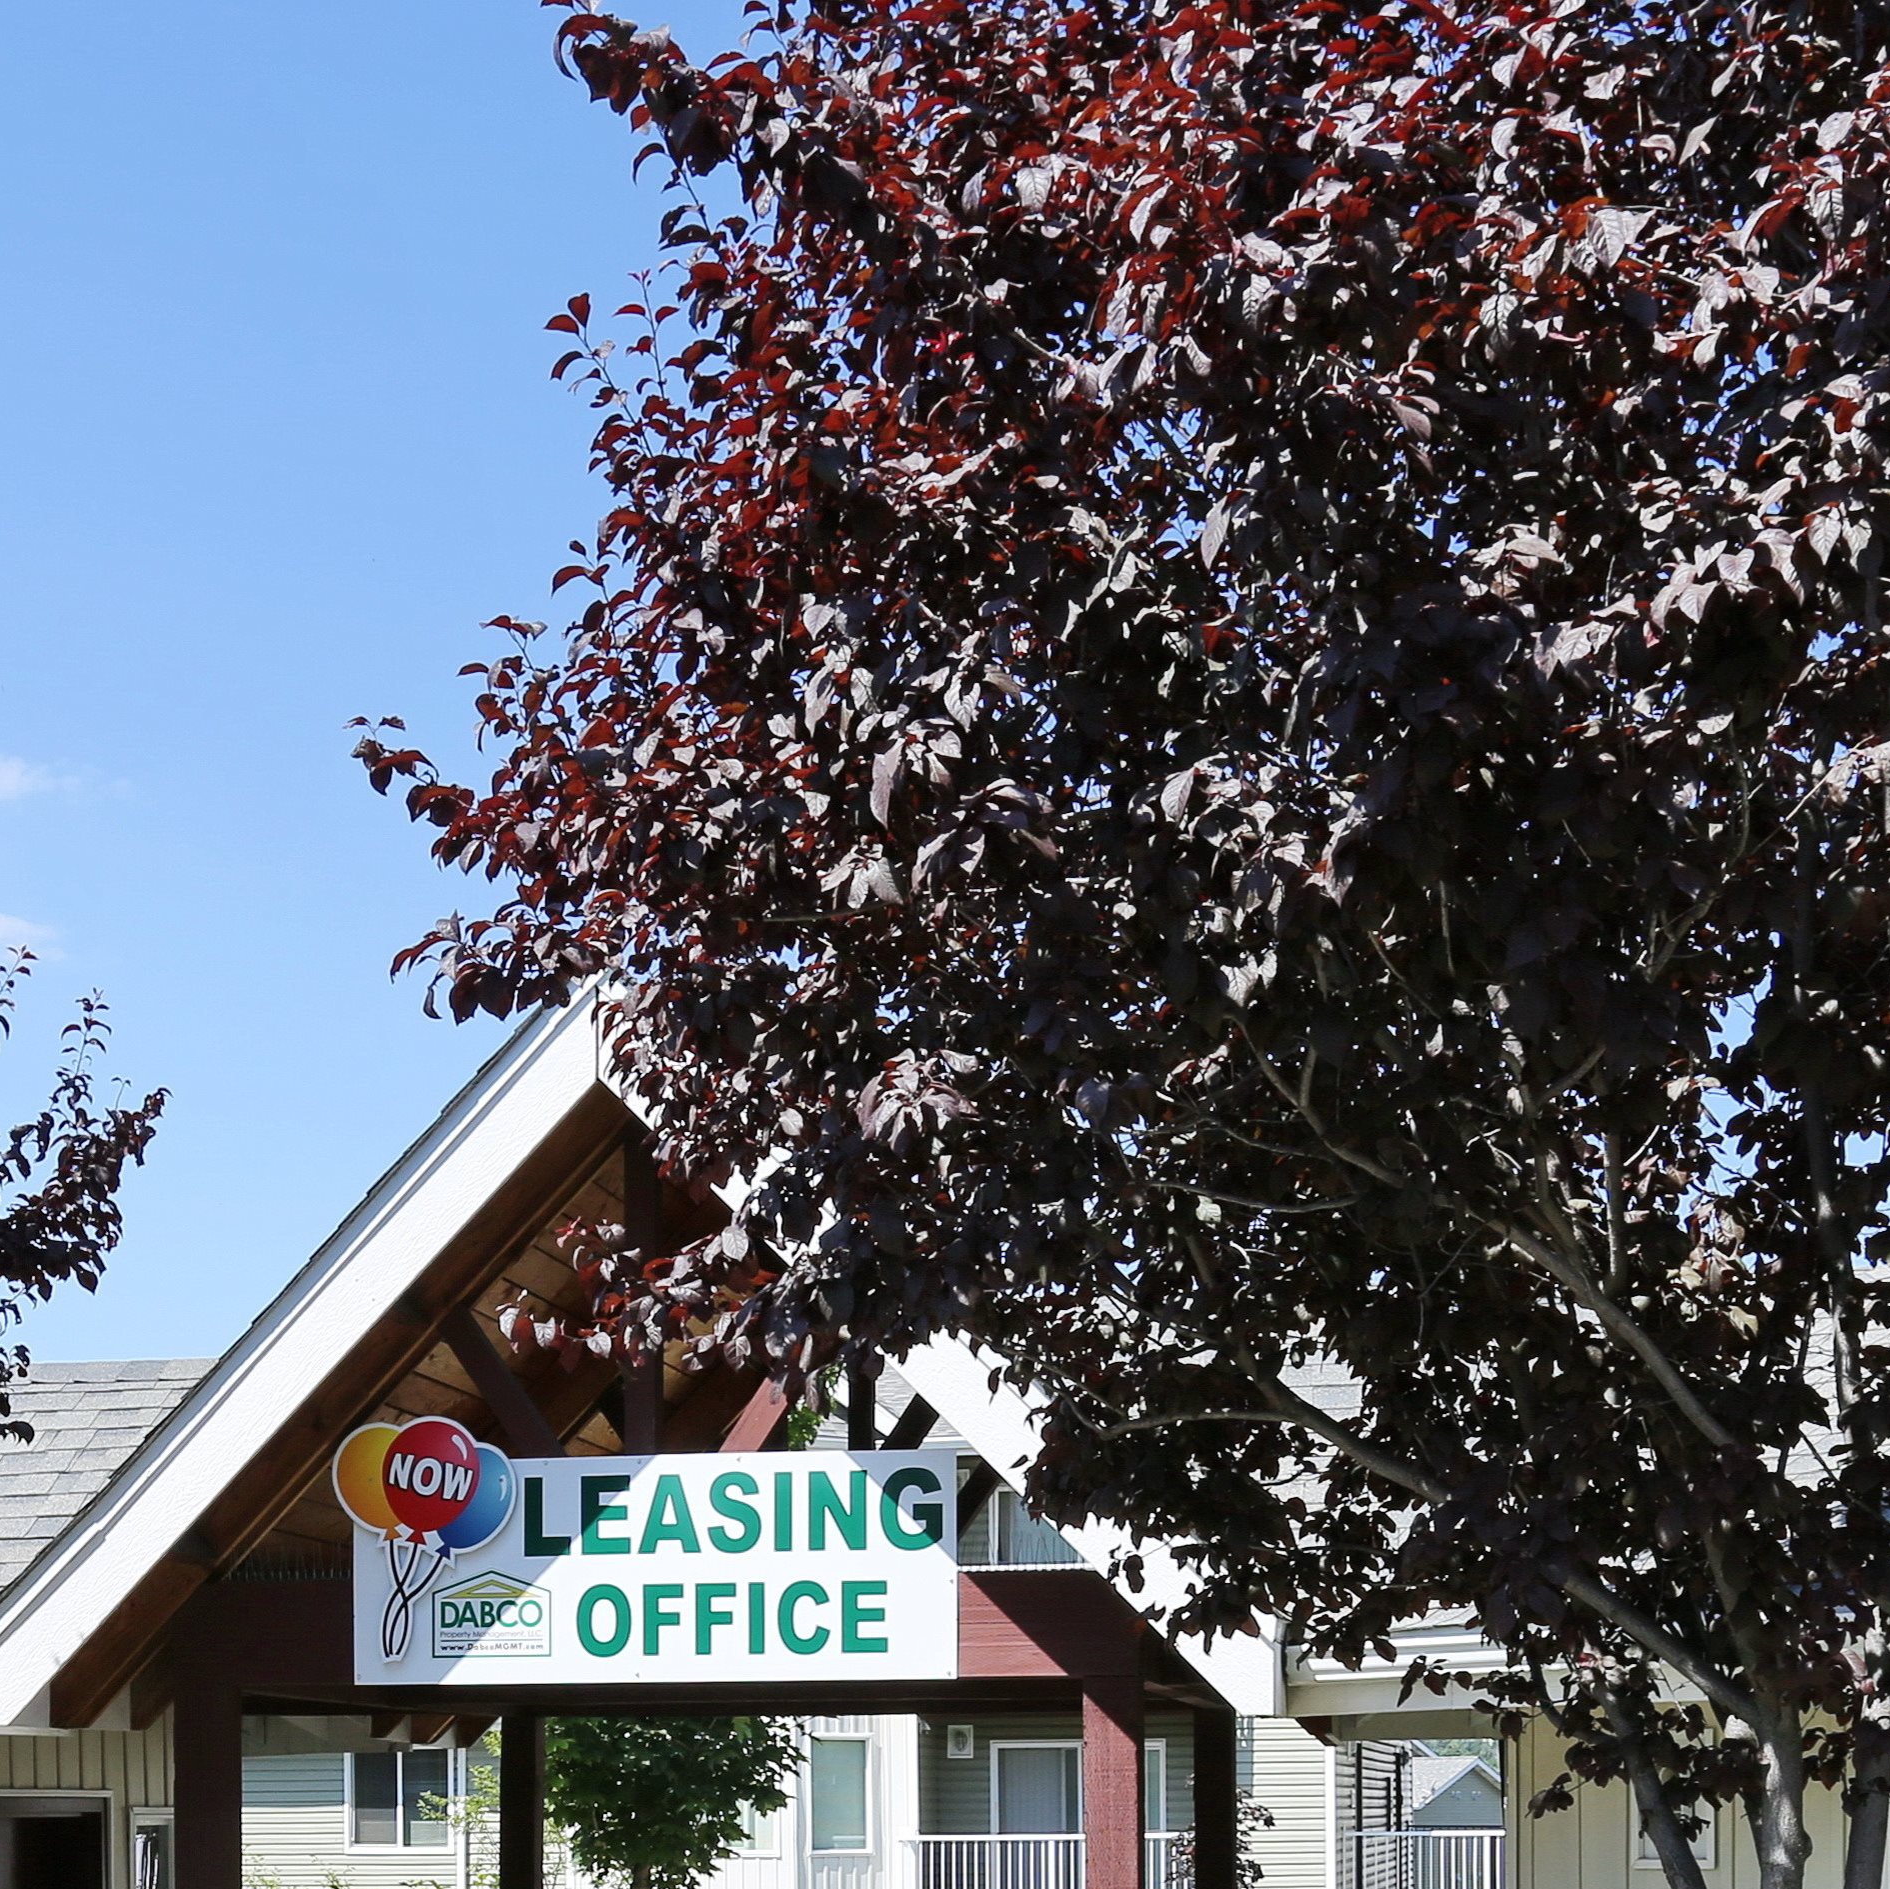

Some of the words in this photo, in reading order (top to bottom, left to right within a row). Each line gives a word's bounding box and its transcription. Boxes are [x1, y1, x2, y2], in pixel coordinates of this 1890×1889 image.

[388, 1452, 474, 1502] NOW
[522, 1466, 945, 1557] LEASING
[440, 1599, 543, 1628] DABCO
[440, 1630, 471, 1639] Property
[576, 1579, 889, 1657] OFFICE
